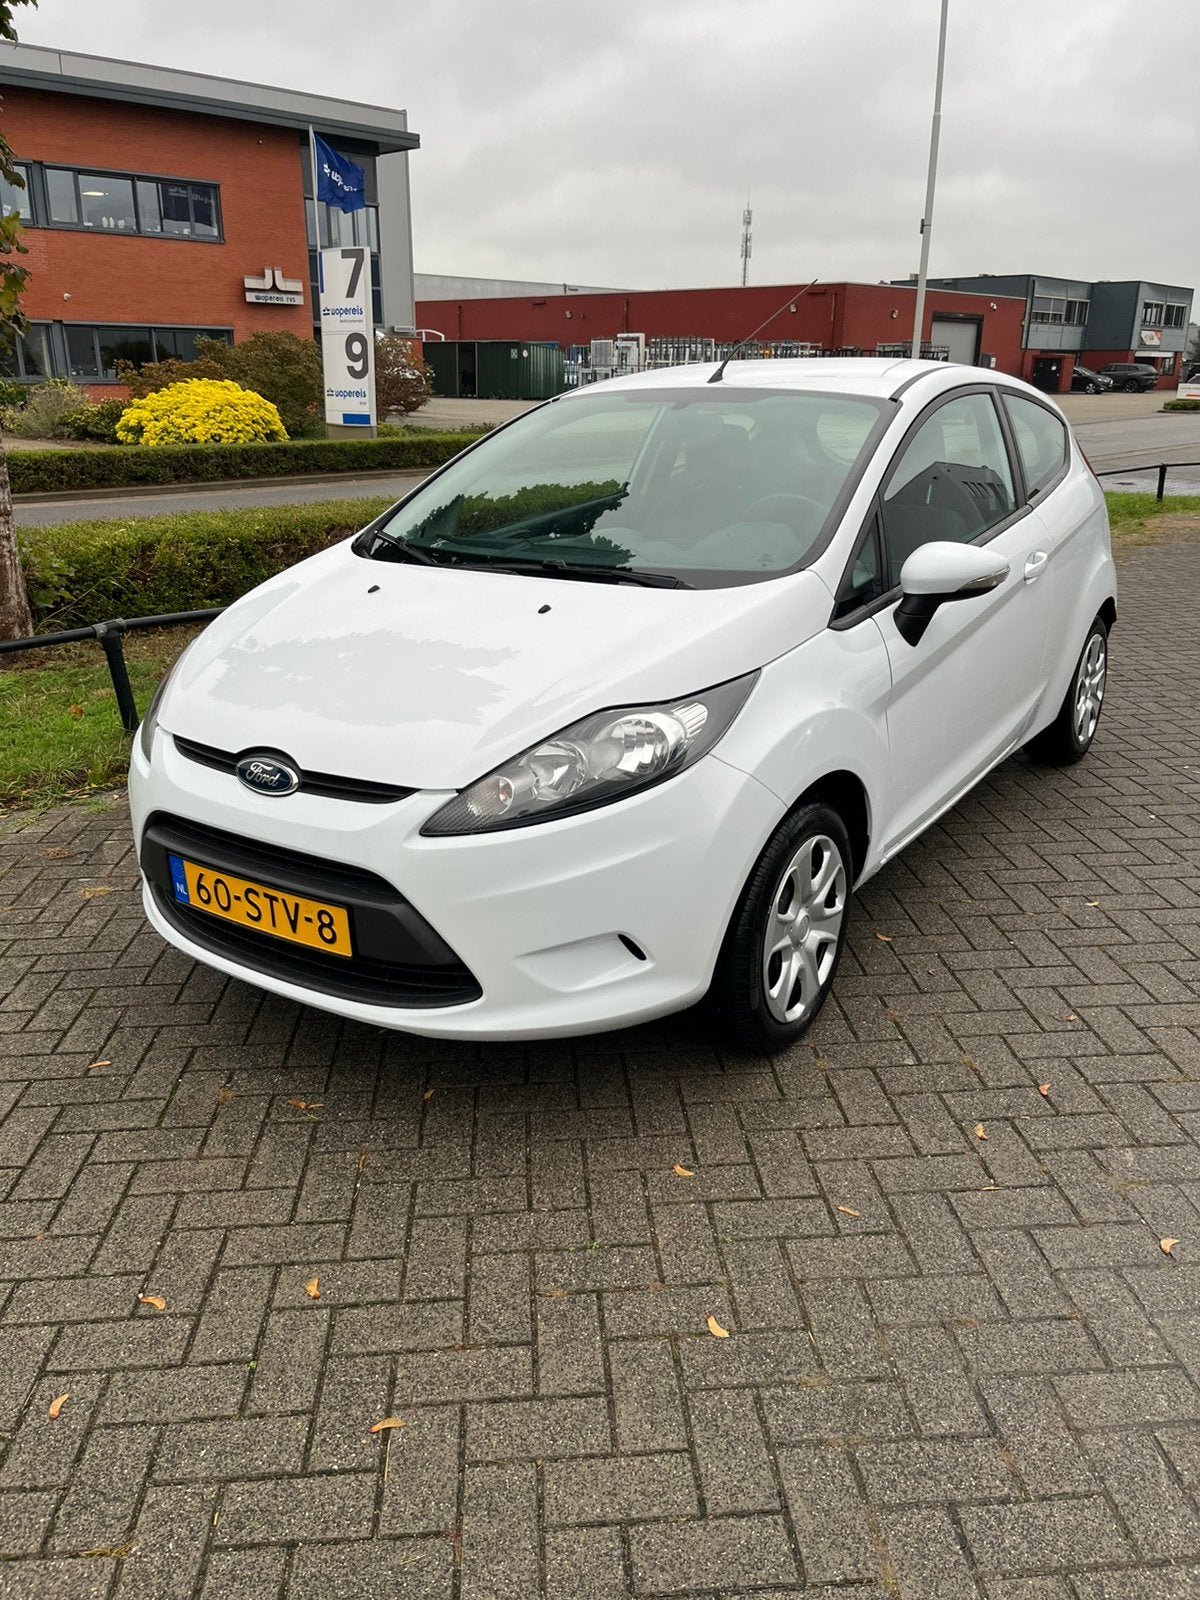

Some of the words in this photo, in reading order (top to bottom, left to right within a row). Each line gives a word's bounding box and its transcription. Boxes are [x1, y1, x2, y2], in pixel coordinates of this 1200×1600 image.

[341, 248, 364, 298] 7
[345, 332, 369, 380] 9
[245, 762, 281, 787] Ford
[176, 883, 187, 895] NL
[196, 873, 337, 944] 60-STV-8
